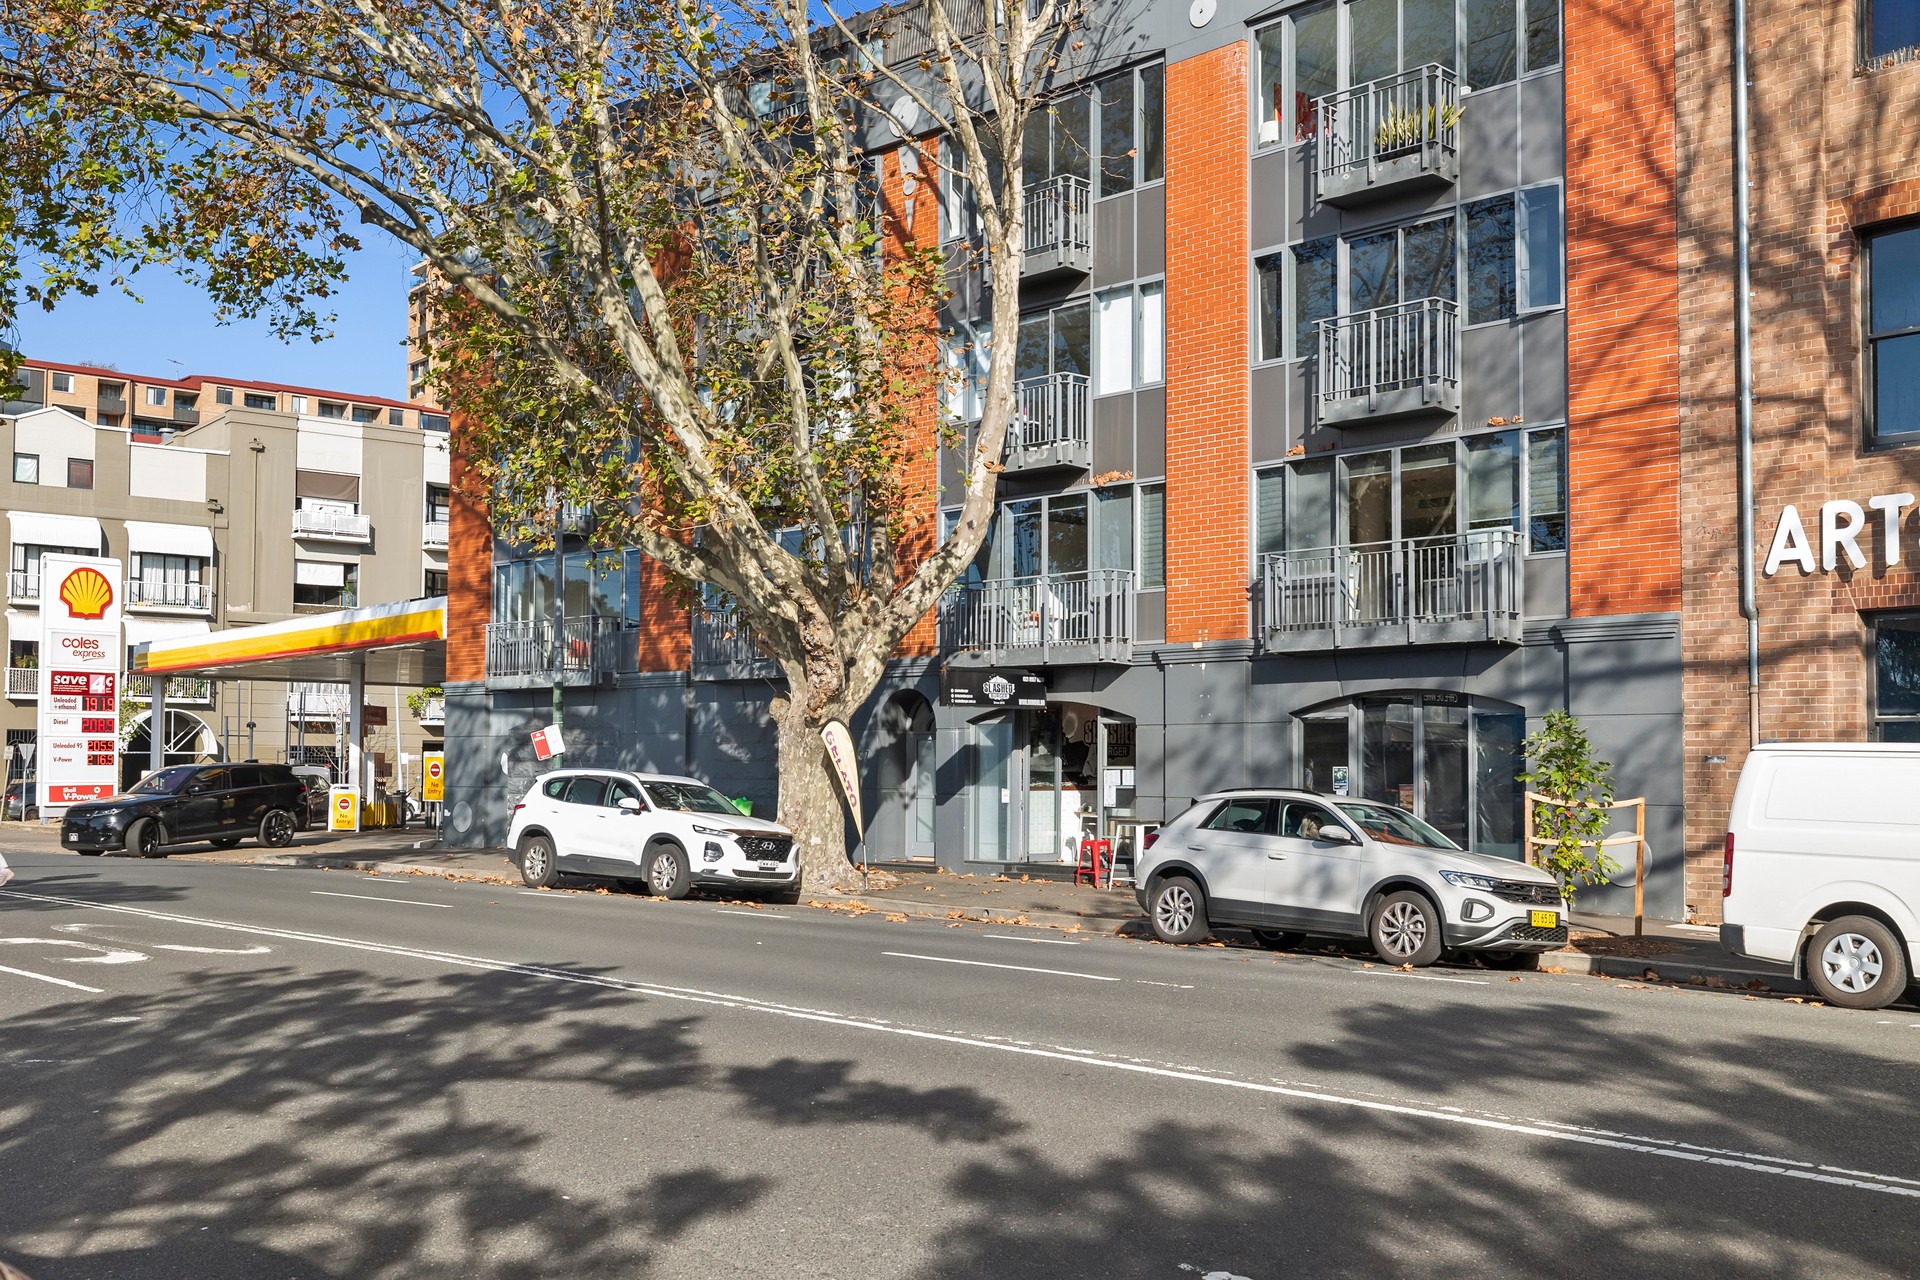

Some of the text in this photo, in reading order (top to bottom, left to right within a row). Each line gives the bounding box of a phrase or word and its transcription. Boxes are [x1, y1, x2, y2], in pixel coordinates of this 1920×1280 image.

[1765, 492, 1920, 575] ART
[62, 637, 99, 649] coles
[73, 650, 106, 659] express
[53, 675, 87, 685] save
[983, 682, 1013, 694] SLASHED
[1108, 746, 1128, 756] RGER
[825, 730, 857, 808] GELATO
[63, 793, 99, 801] V-Power
